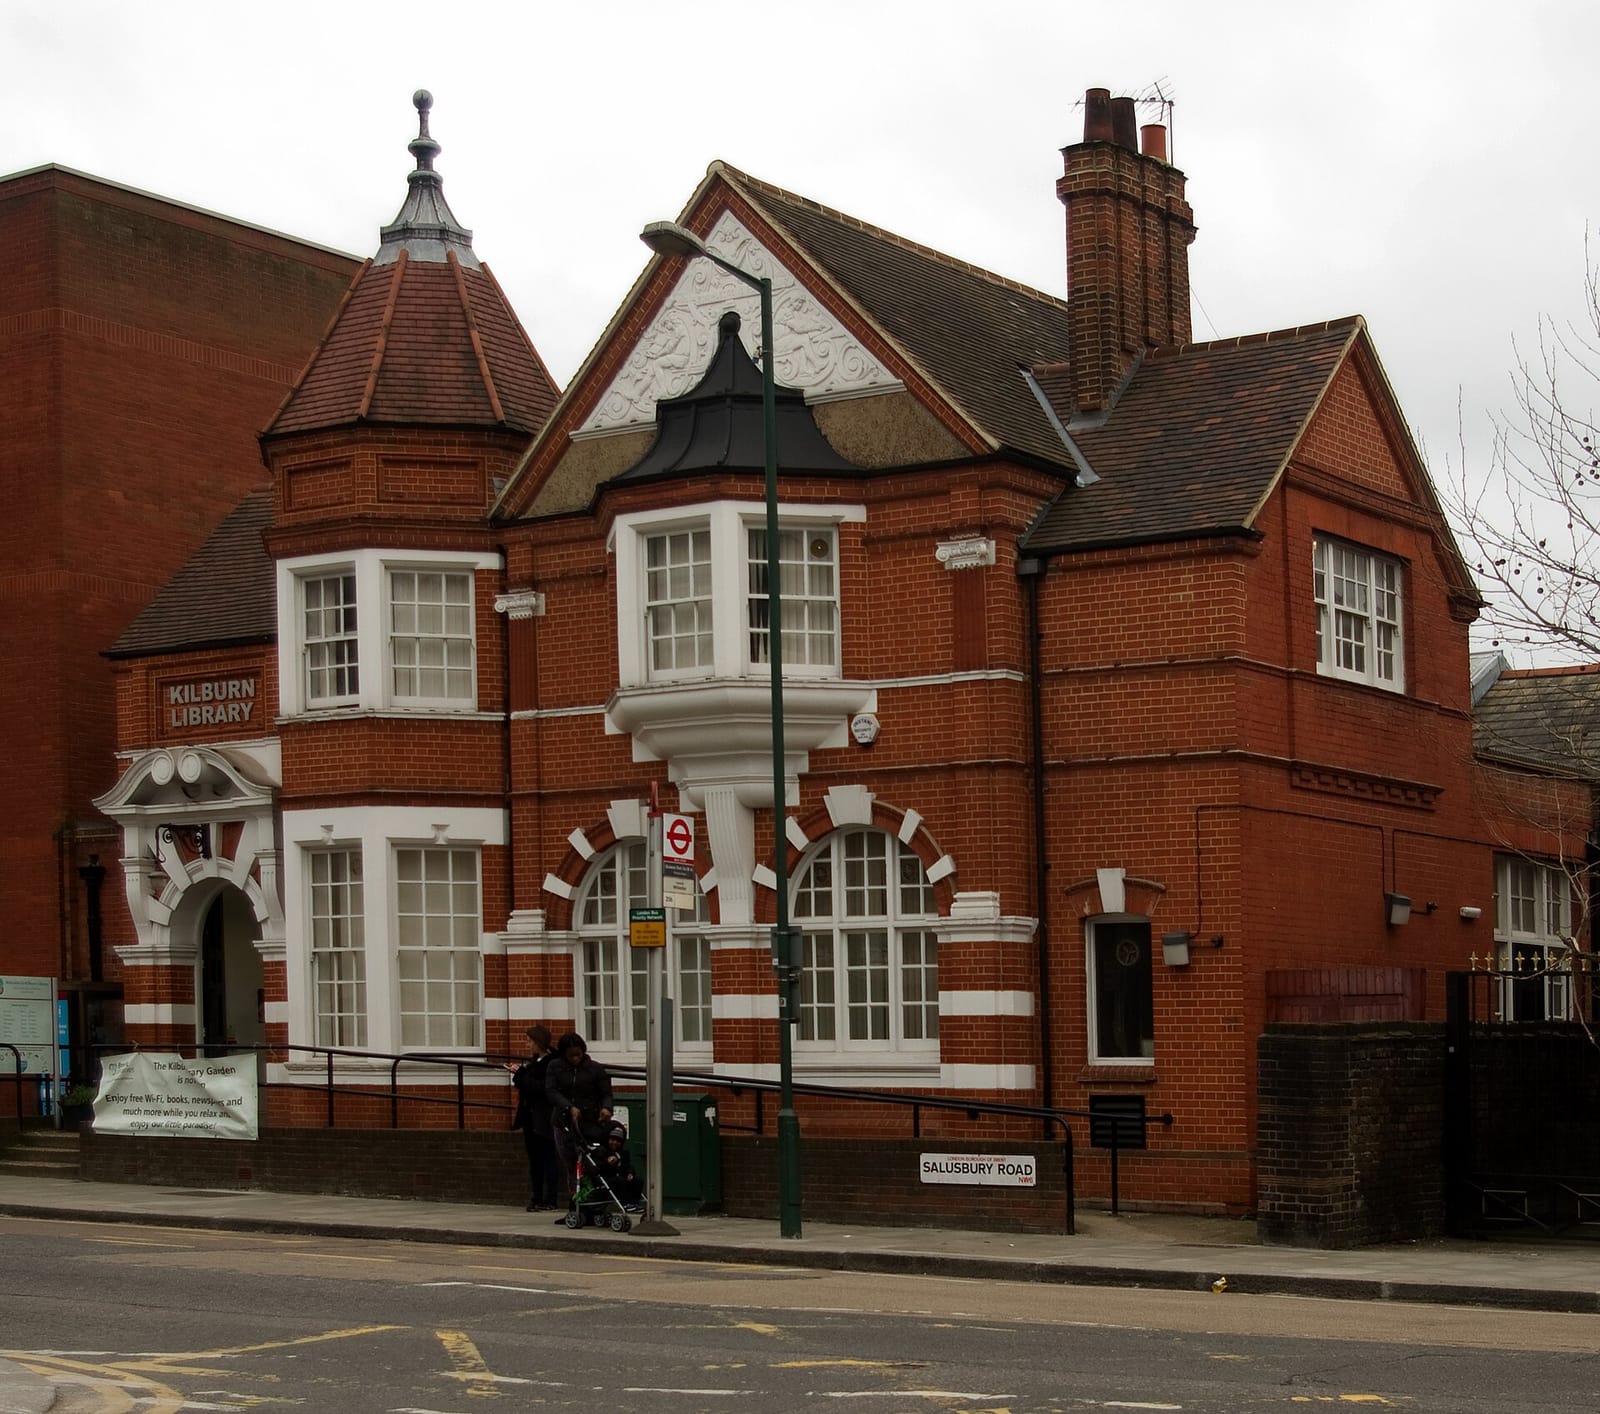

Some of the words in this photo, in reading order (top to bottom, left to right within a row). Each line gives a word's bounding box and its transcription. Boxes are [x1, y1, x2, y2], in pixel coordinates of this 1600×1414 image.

[169, 678, 255, 705] KILBURN
[171, 702, 254, 727] LIBRARY
[153, 1062, 167, 1071] The
[168, 1062, 186, 1071] Kilbu
[206, 1066, 236, 1076] Garden
[177, 1076, 183, 1084] is
[105, 1094, 129, 1106] Enjoy
[129, 1094, 144, 1103] free
[166, 1094, 190, 1105] books,
[226, 1096, 243, 1106] and
[122, 1107, 142, 1116] much
[143, 1109, 161, 1117] more
[163, 1108, 183, 1117] while
[184, 1110, 199, 1119] you
[199, 1109, 217, 1118] relax
[130, 1121, 150, 1130] enjoy
[922, 1161, 993, 1175] SALUSBURY
[997, 1163, 1033, 1176] ROAD
[1018, 1176, 1033, 1184] NW6
